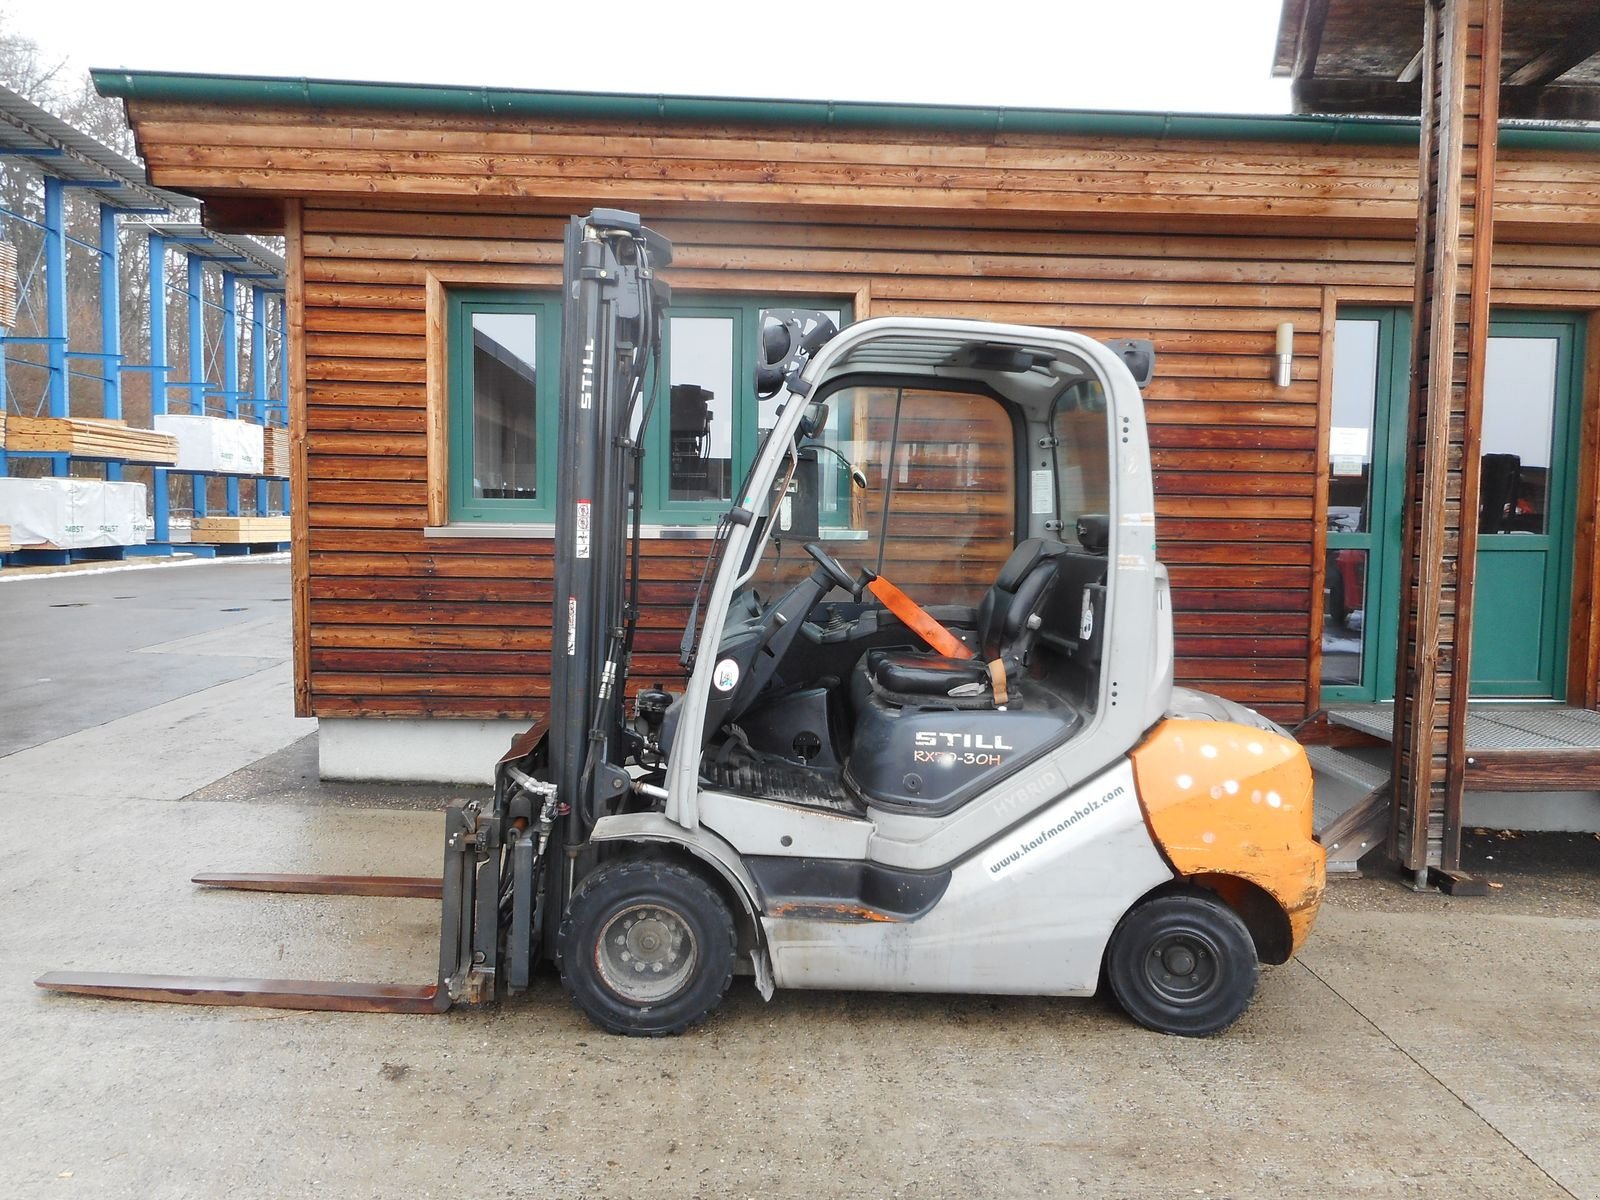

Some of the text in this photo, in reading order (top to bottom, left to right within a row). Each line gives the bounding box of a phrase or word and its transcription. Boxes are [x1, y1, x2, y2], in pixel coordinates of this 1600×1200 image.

[581, 338, 594, 410] STILL
[915, 731, 1013, 750] STILL
[990, 785, 1125, 874] www.kaufmannholz.com
